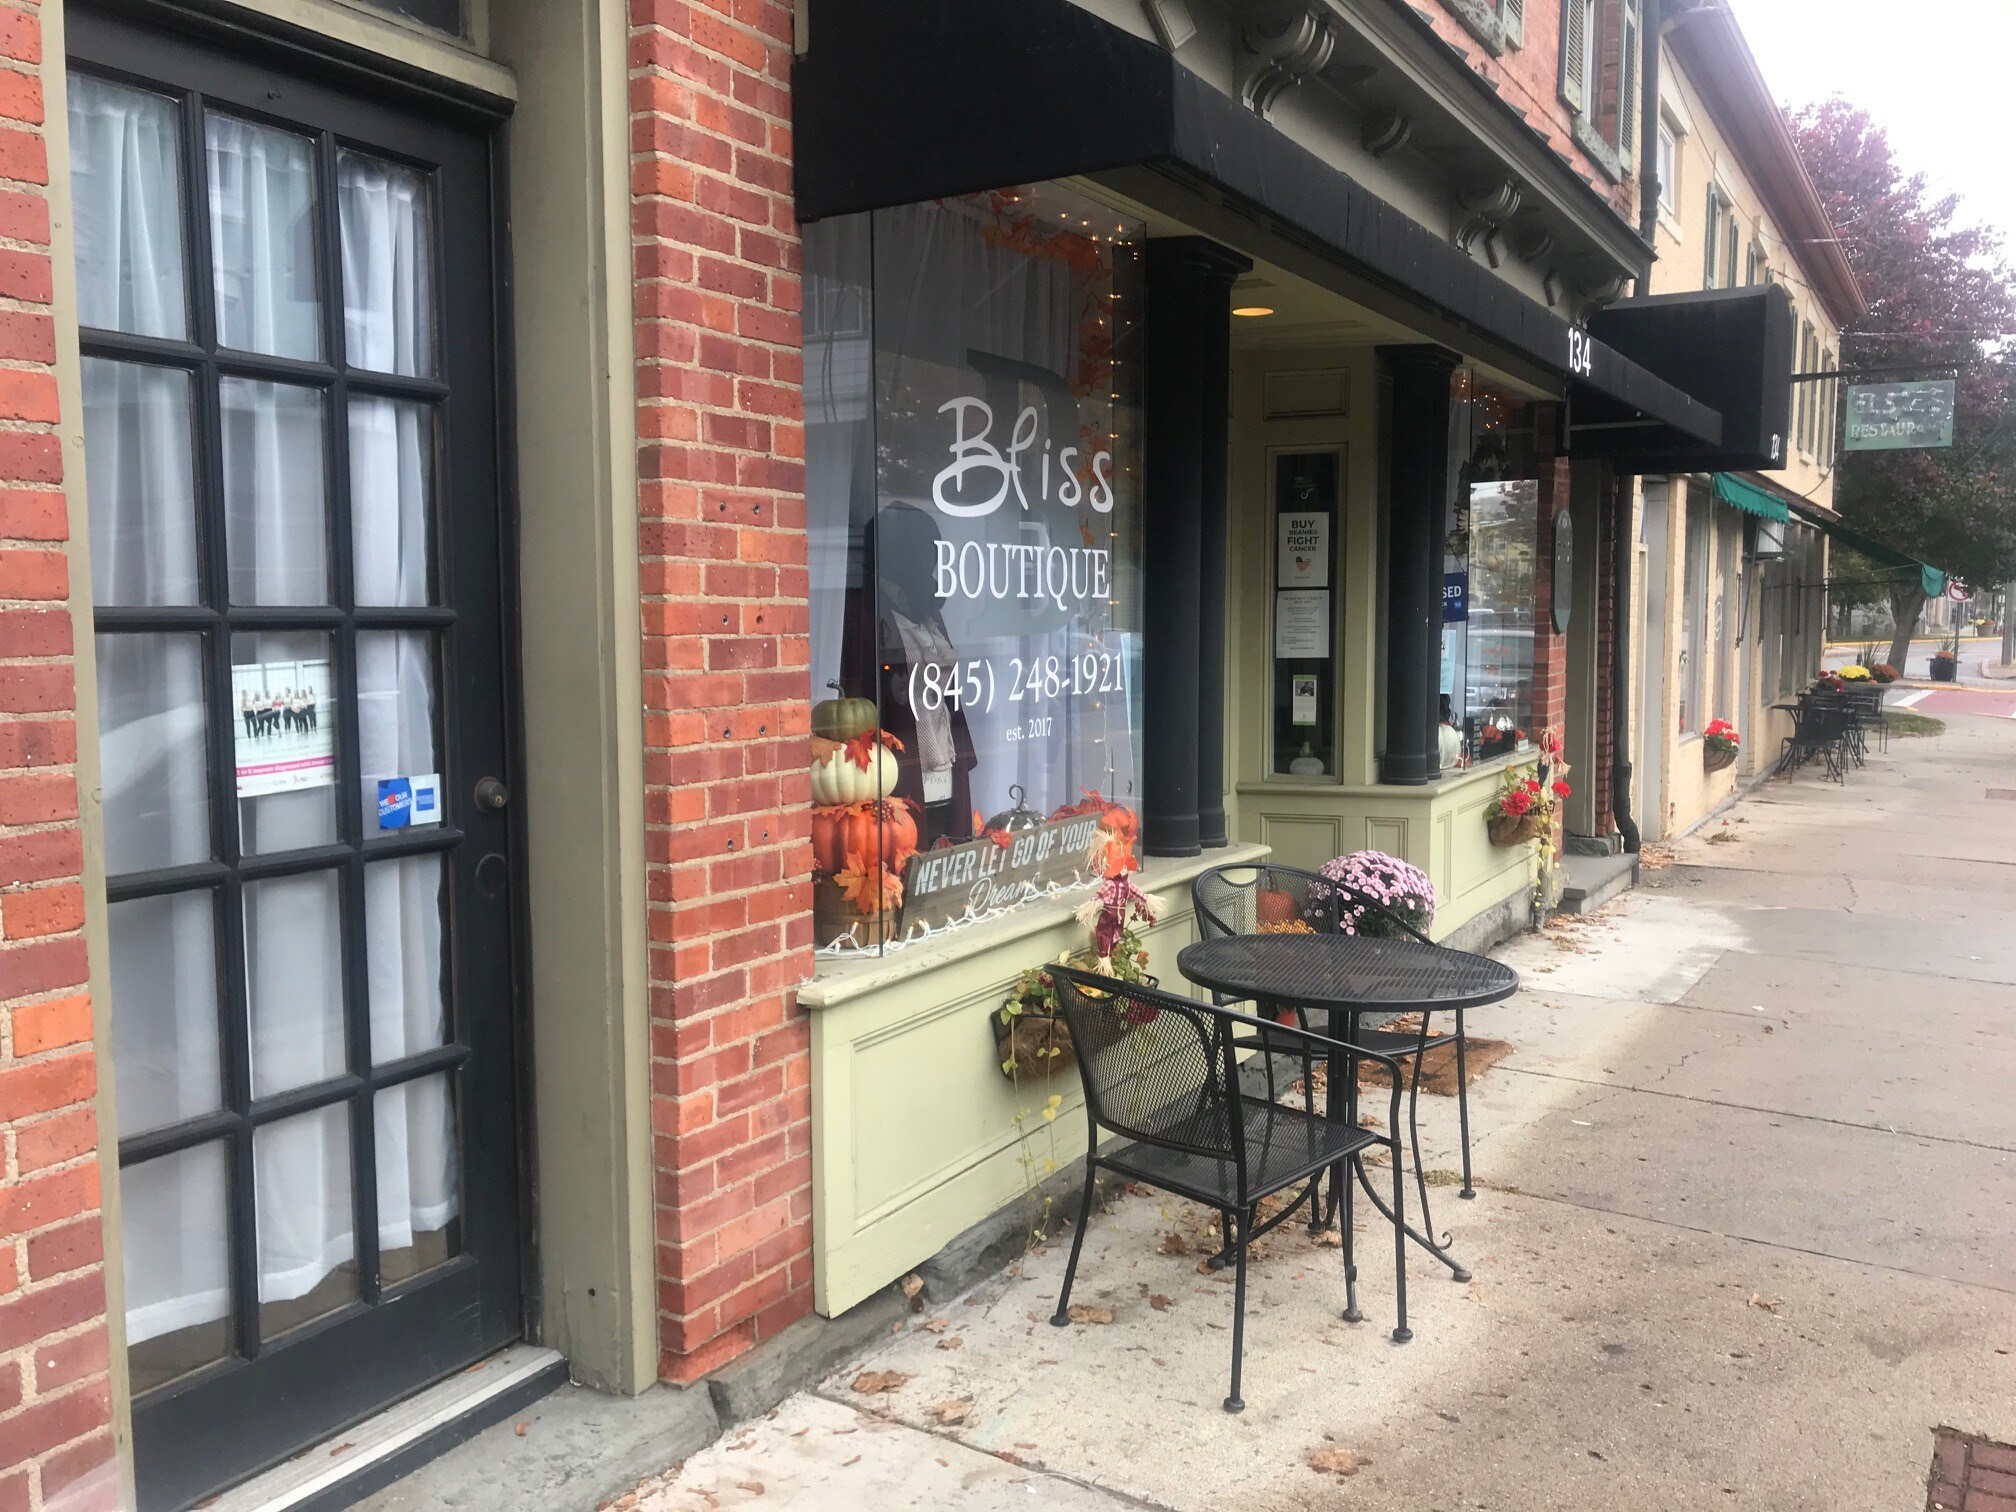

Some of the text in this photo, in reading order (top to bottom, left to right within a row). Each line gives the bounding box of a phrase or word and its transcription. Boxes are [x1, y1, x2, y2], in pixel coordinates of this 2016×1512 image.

[1568, 327, 1592, 377] 134
[932, 396, 1115, 517] Bliss
[1287, 536, 1319, 545] FIGHT
[1291, 520, 1315, 529] BUY
[933, 539, 1111, 612] BOUTIQUE
[907, 652, 1124, 722] (845) 248-1921
[1006, 716, 1053, 742] est. 2017
[379, 798, 388, 807] WE
[395, 791, 408, 802] OUR
[379, 797, 413, 817] CUSTOMERS
[915, 850, 977, 896] NEVER
[1011, 835, 1035, 869] GO
[1036, 829, 1058, 862] OF
